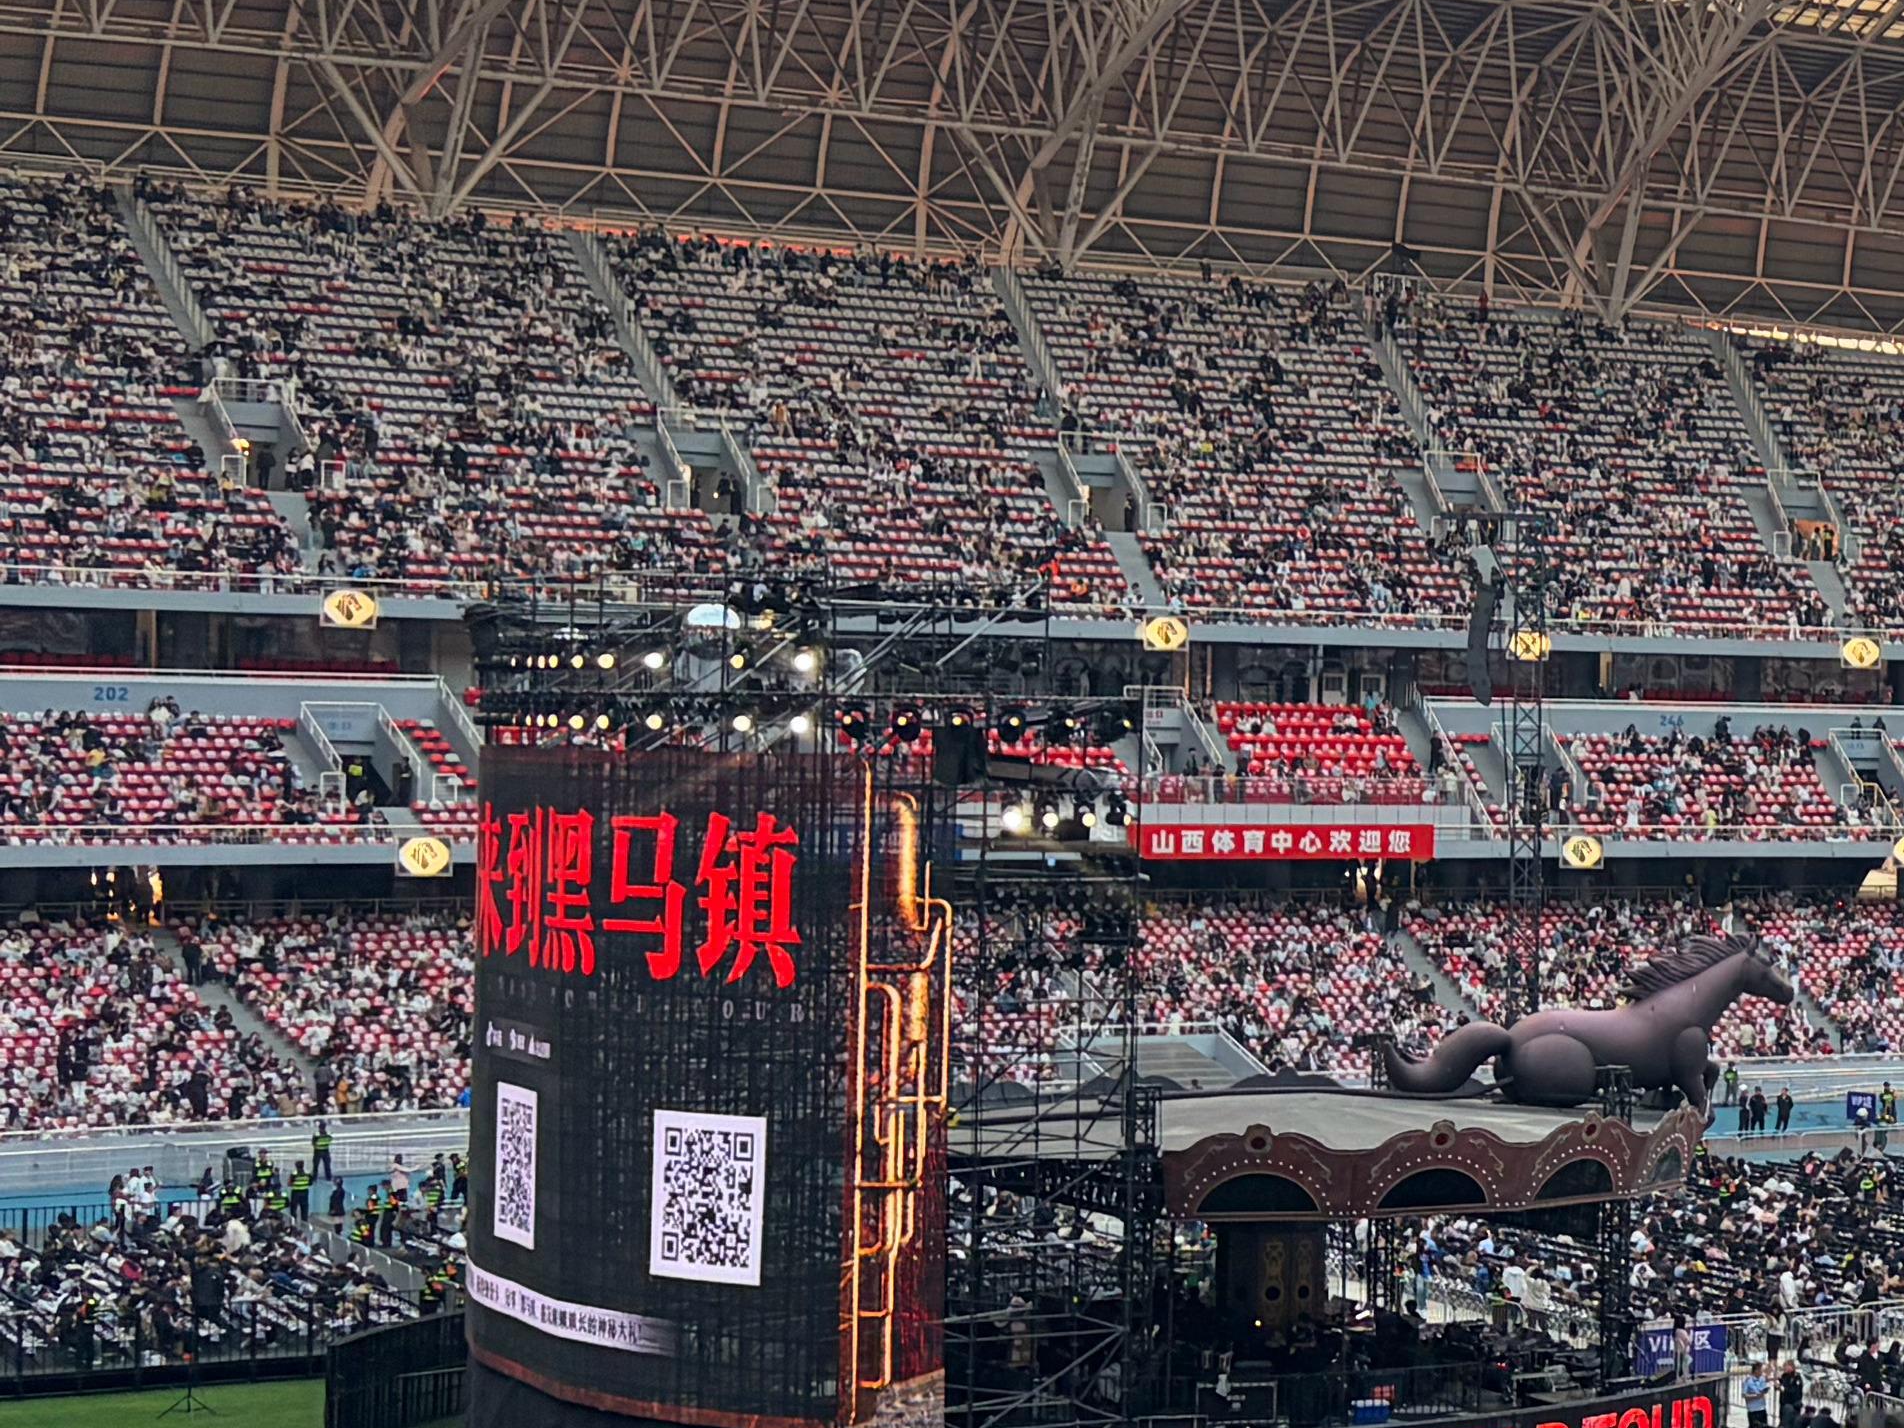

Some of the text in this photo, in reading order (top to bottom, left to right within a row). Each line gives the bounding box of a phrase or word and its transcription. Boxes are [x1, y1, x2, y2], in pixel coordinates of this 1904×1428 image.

[94, 686, 129, 702] 202
[1151, 829, 1412, 855] 山西体育中心欢迎您
[477, 801, 802, 990] 来到黑马镇
